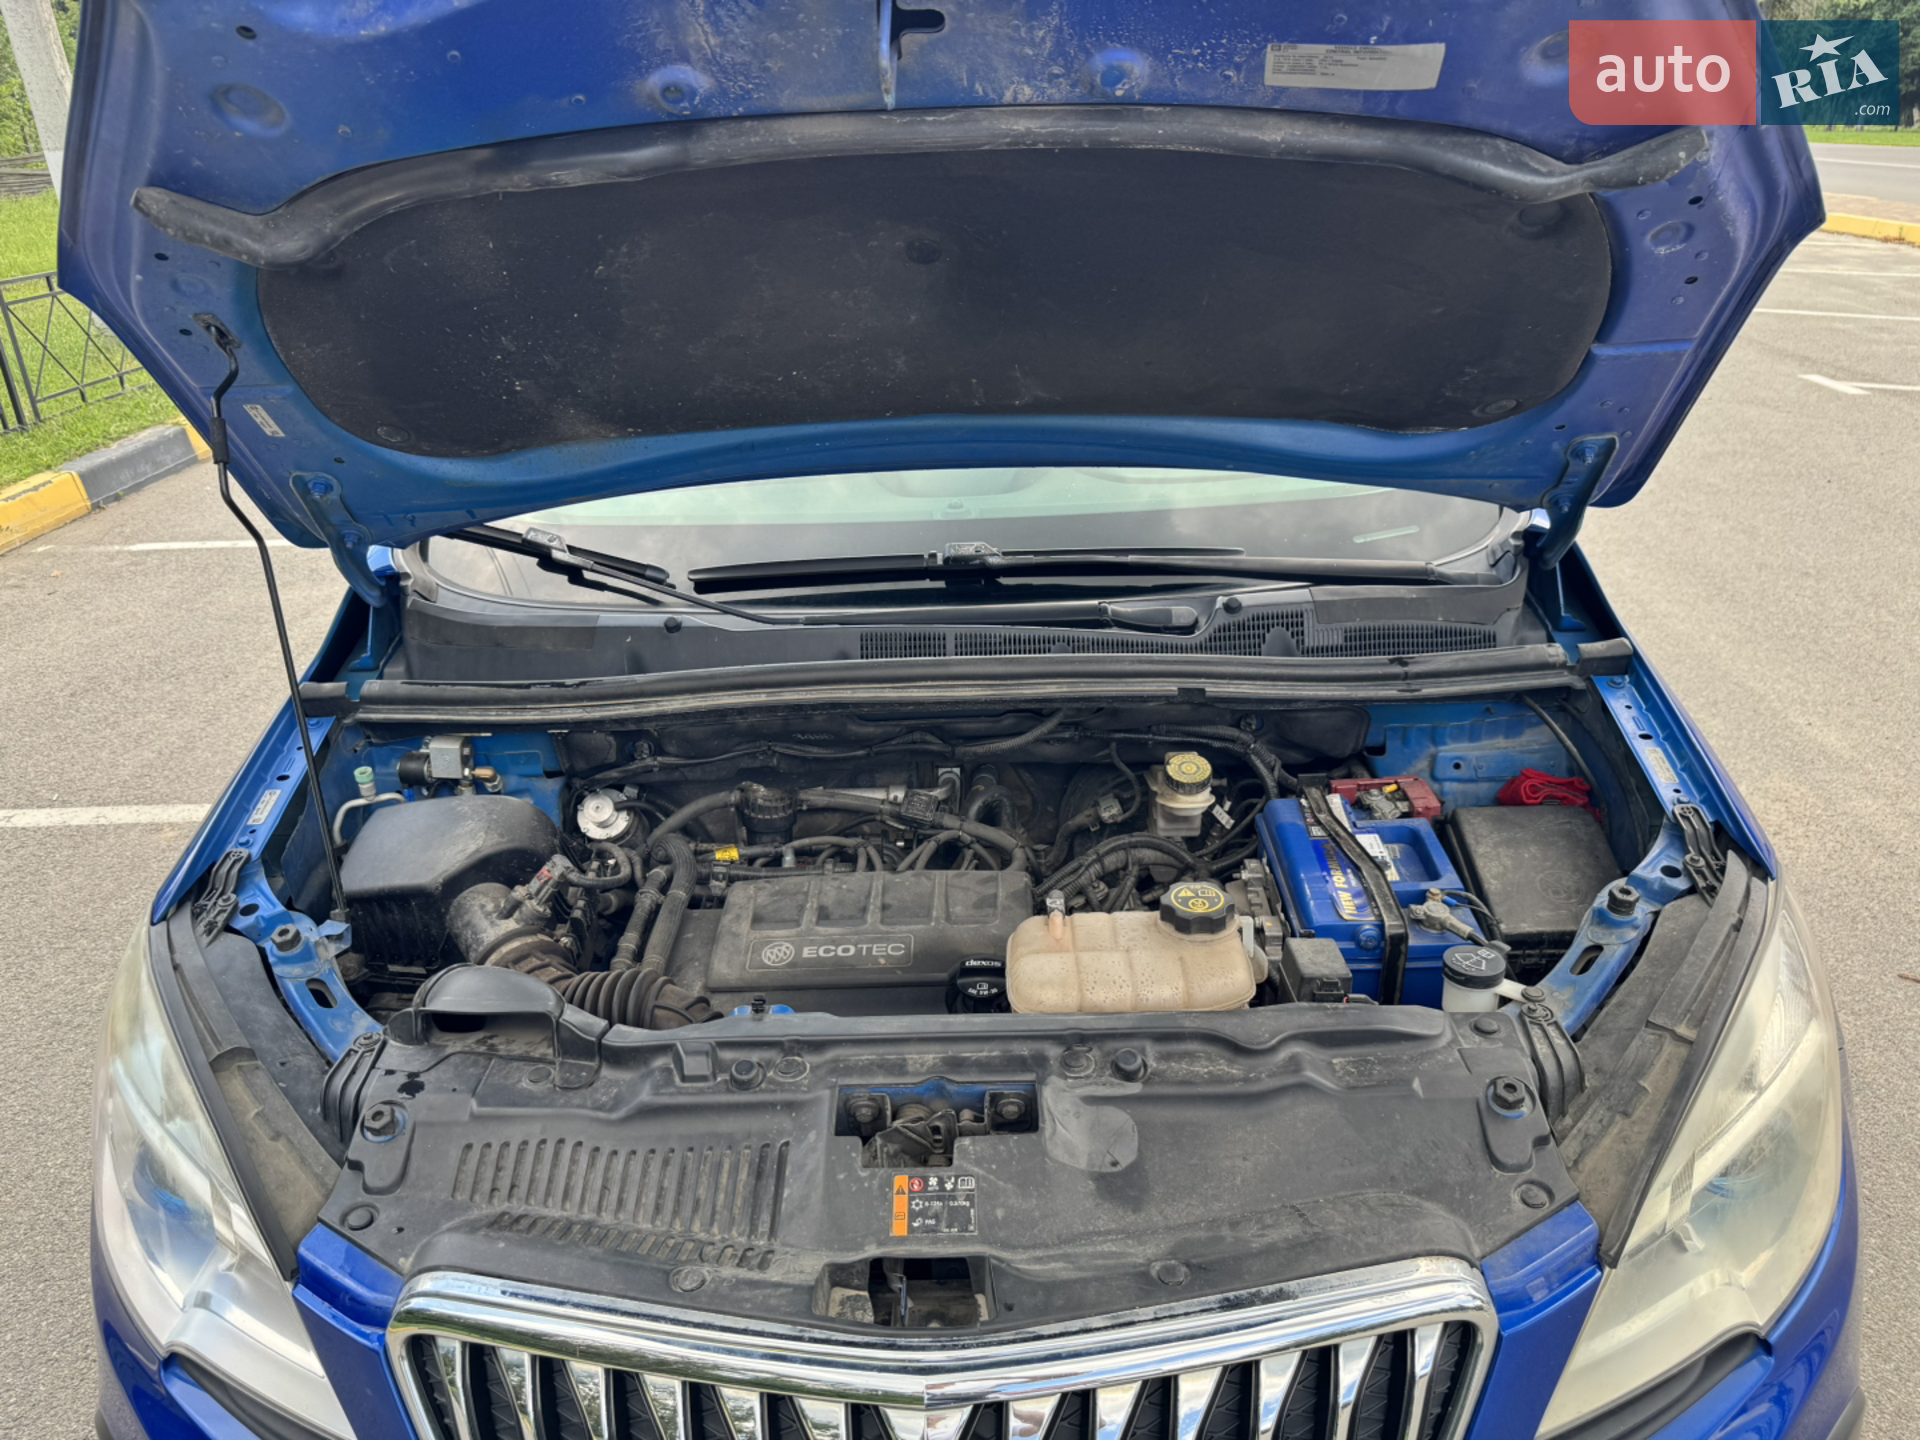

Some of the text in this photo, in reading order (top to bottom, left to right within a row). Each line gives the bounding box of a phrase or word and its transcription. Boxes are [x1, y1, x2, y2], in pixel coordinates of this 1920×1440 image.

[1322, 844, 1349, 888] FORMULA
[1337, 890, 1358, 915] NEW
[802, 943, 905, 958] ECOTEC
[965, 959, 1001, 967] dexos
